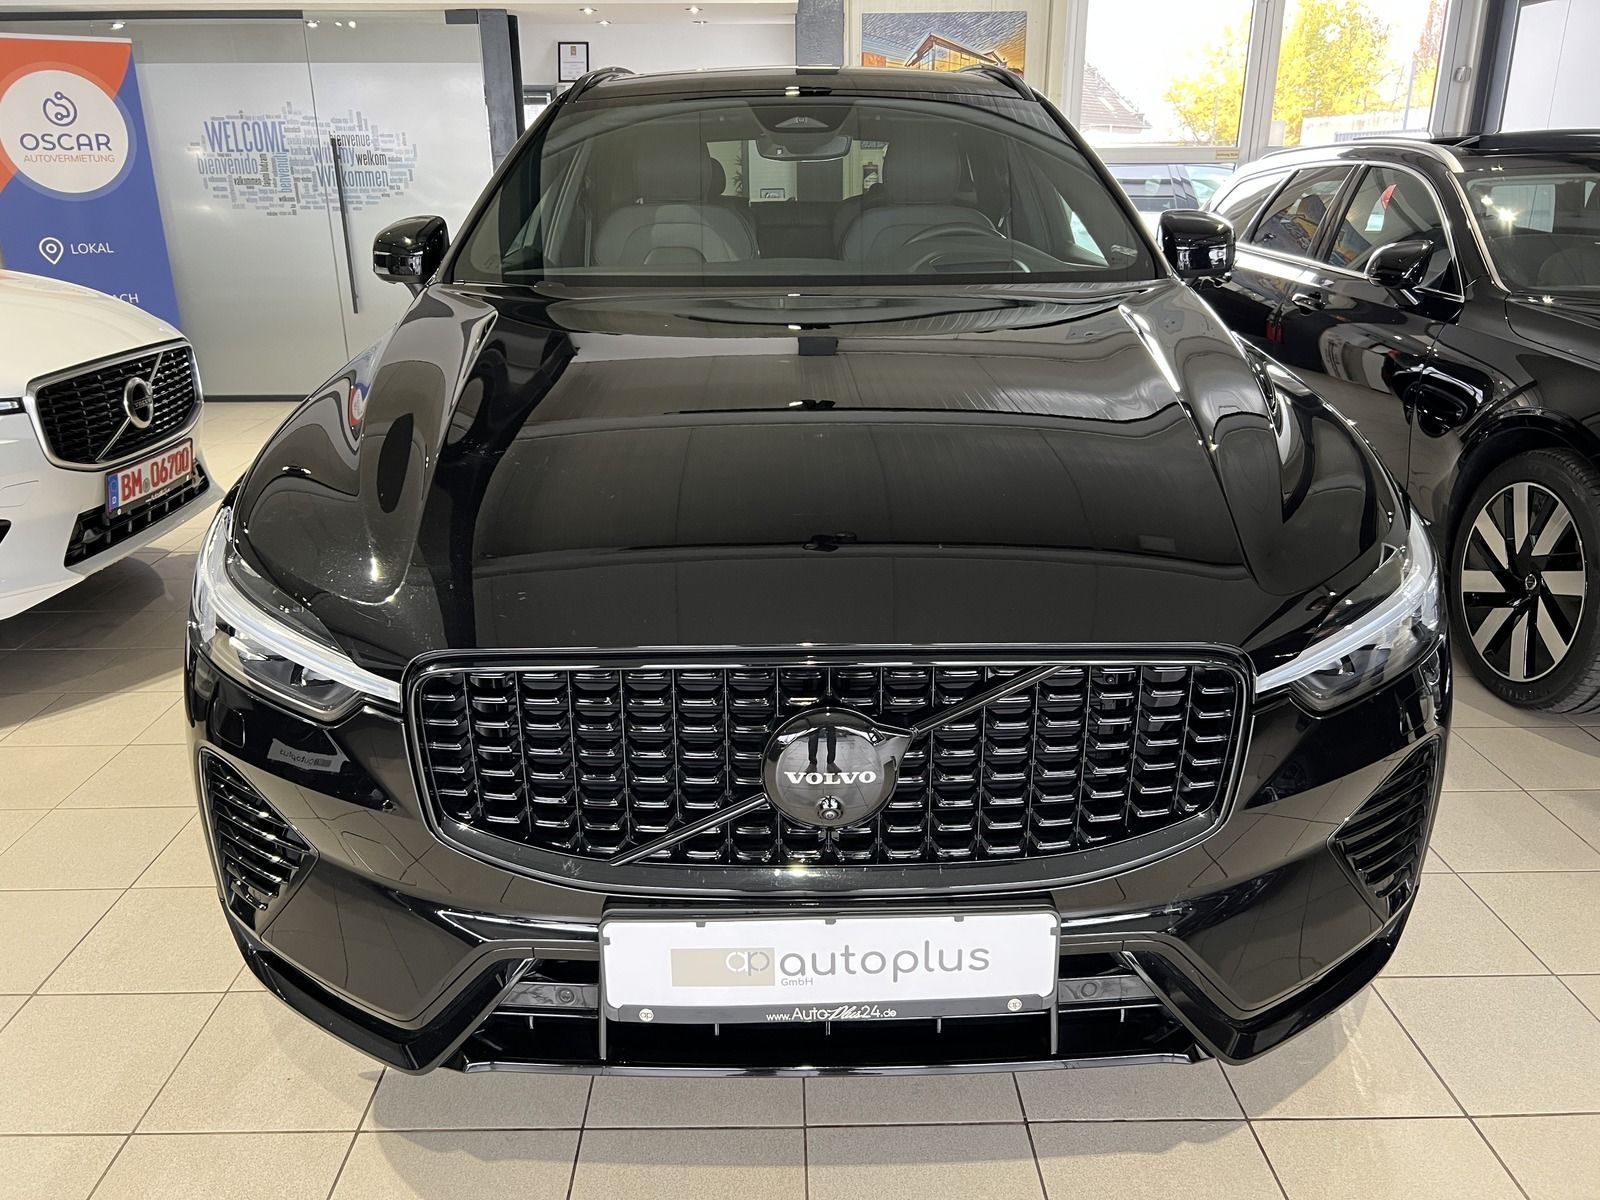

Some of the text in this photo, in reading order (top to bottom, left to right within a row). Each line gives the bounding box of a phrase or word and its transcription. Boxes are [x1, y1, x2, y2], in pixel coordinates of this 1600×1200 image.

[19, 133, 112, 151] OSCAR
[203, 120, 290, 152] WELCOME
[24, 154, 115, 163] AUTOVERMIETUNG
[197, 152, 258, 175] bienvenido
[355, 150, 388, 166] welkom
[316, 165, 389, 187] Wikommen
[70, 242, 114, 255] LOKAL
[121, 468, 143, 501] BM
[150, 447, 189, 488] 06700
[784, 771, 877, 785] VOLVO
[780, 940, 990, 983] autoplus
[780, 978, 814, 986] GmbH
